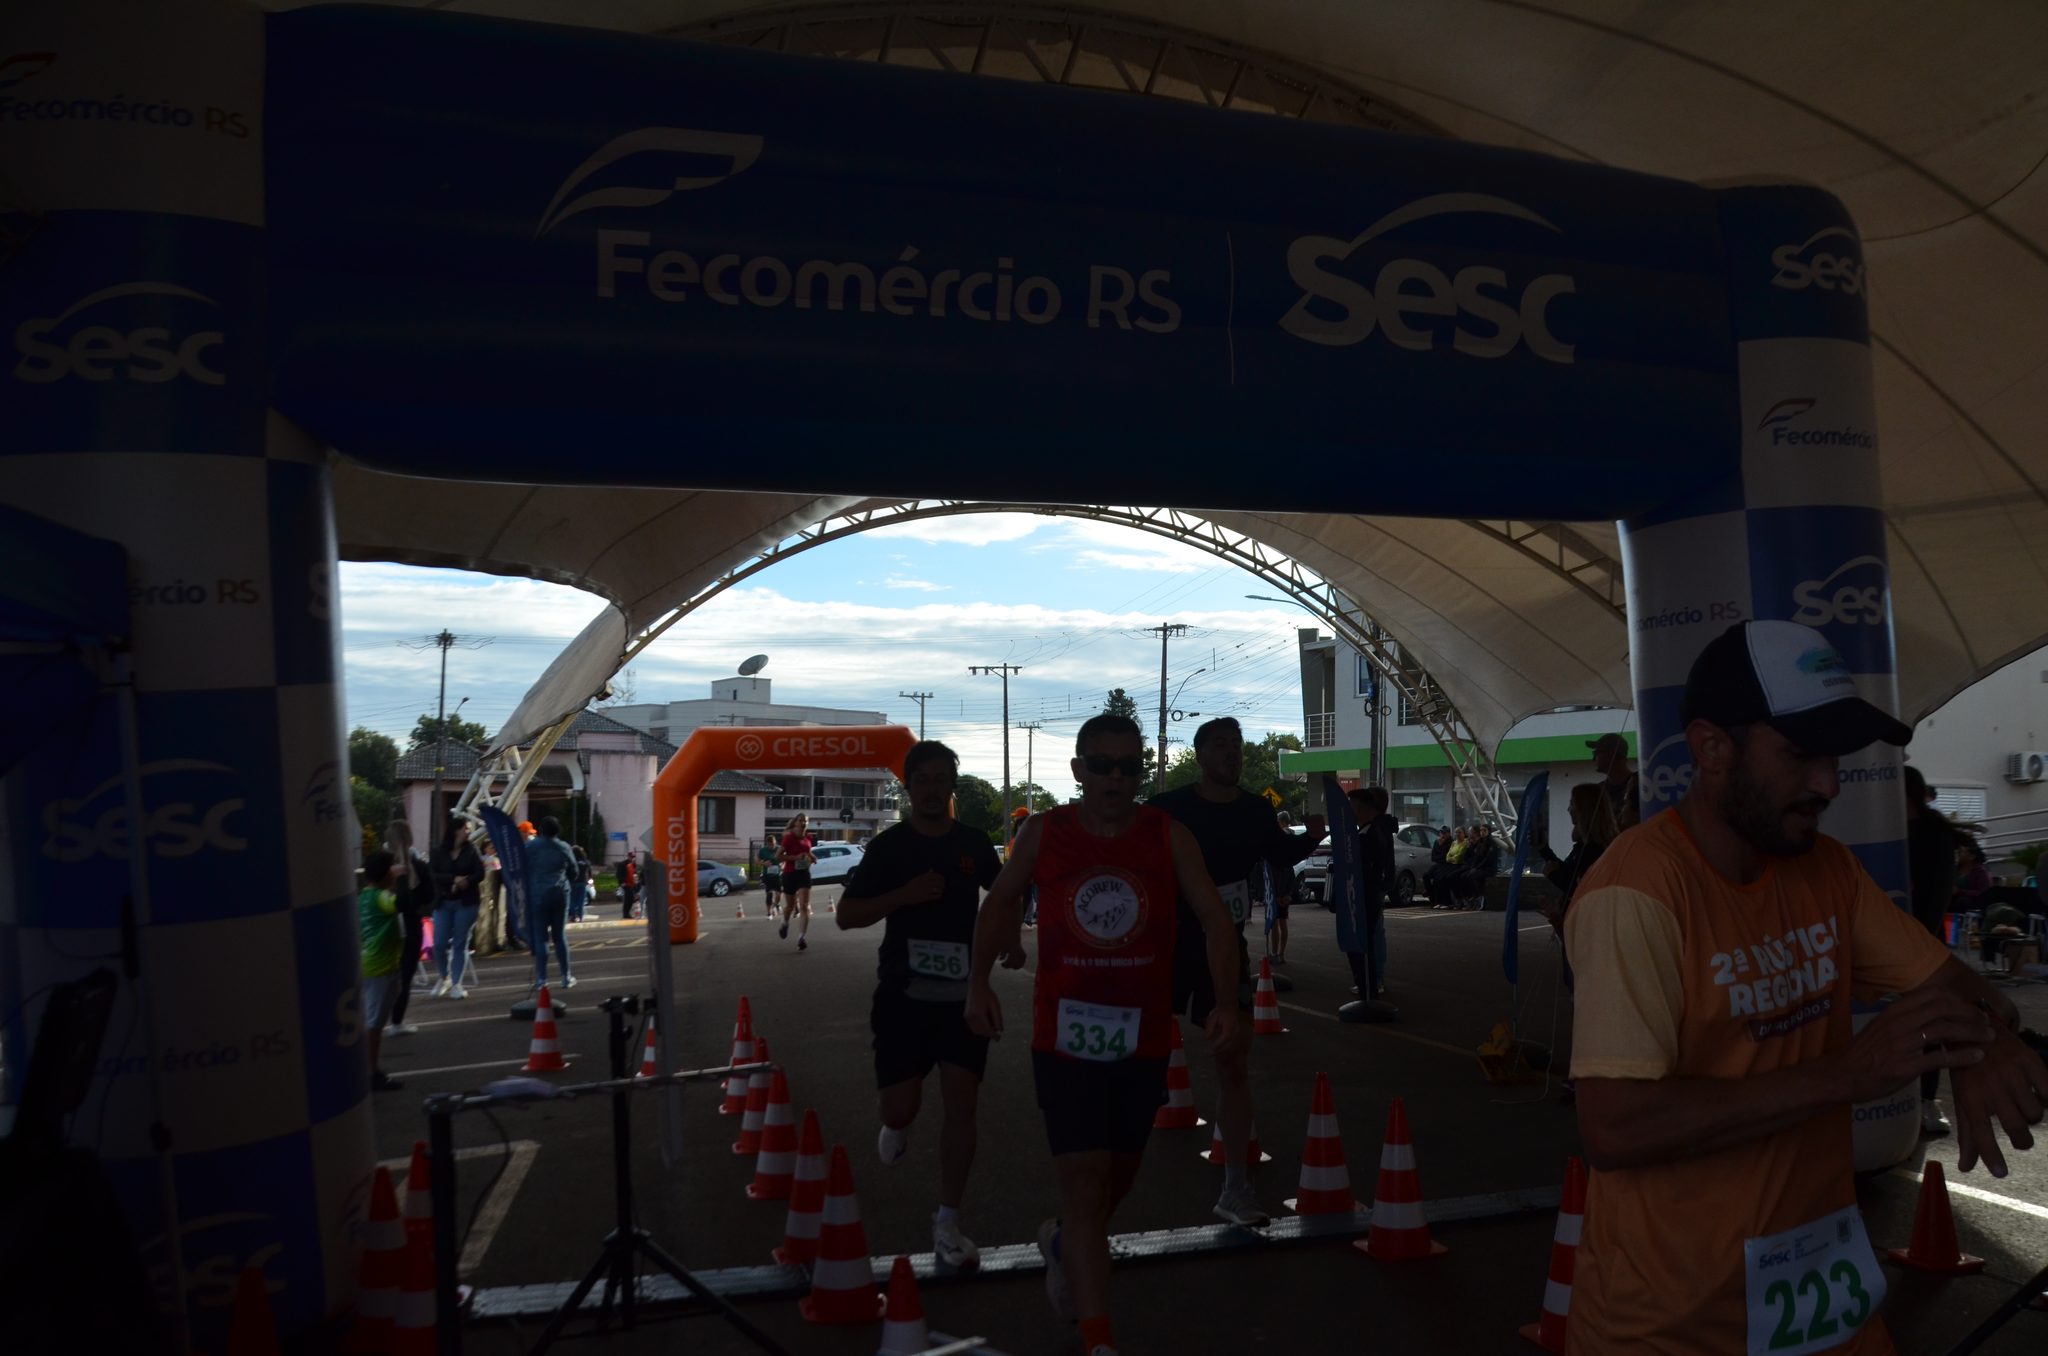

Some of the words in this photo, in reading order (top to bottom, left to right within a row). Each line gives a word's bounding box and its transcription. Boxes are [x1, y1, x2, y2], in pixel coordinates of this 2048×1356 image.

[205, 106, 249, 138] RS
[597, 228, 1062, 326] Fecomércio
[1086, 264, 1182, 335] RS
[1276, 233, 1577, 365] Sesc
[12, 317, 227, 386] Sesc
[217, 579, 260, 605] RS
[1710, 601, 1742, 621] RS
[773, 736, 876, 757] CRESOL
[40, 797, 249, 862] Sesc
[668, 809, 686, 897] CRESOL
[917, 951, 962, 976] 256
[249, 1029, 290, 1061] RS
[1067, 1022, 1128, 1057] 334
[1765, 1259, 1870, 1351] 223
